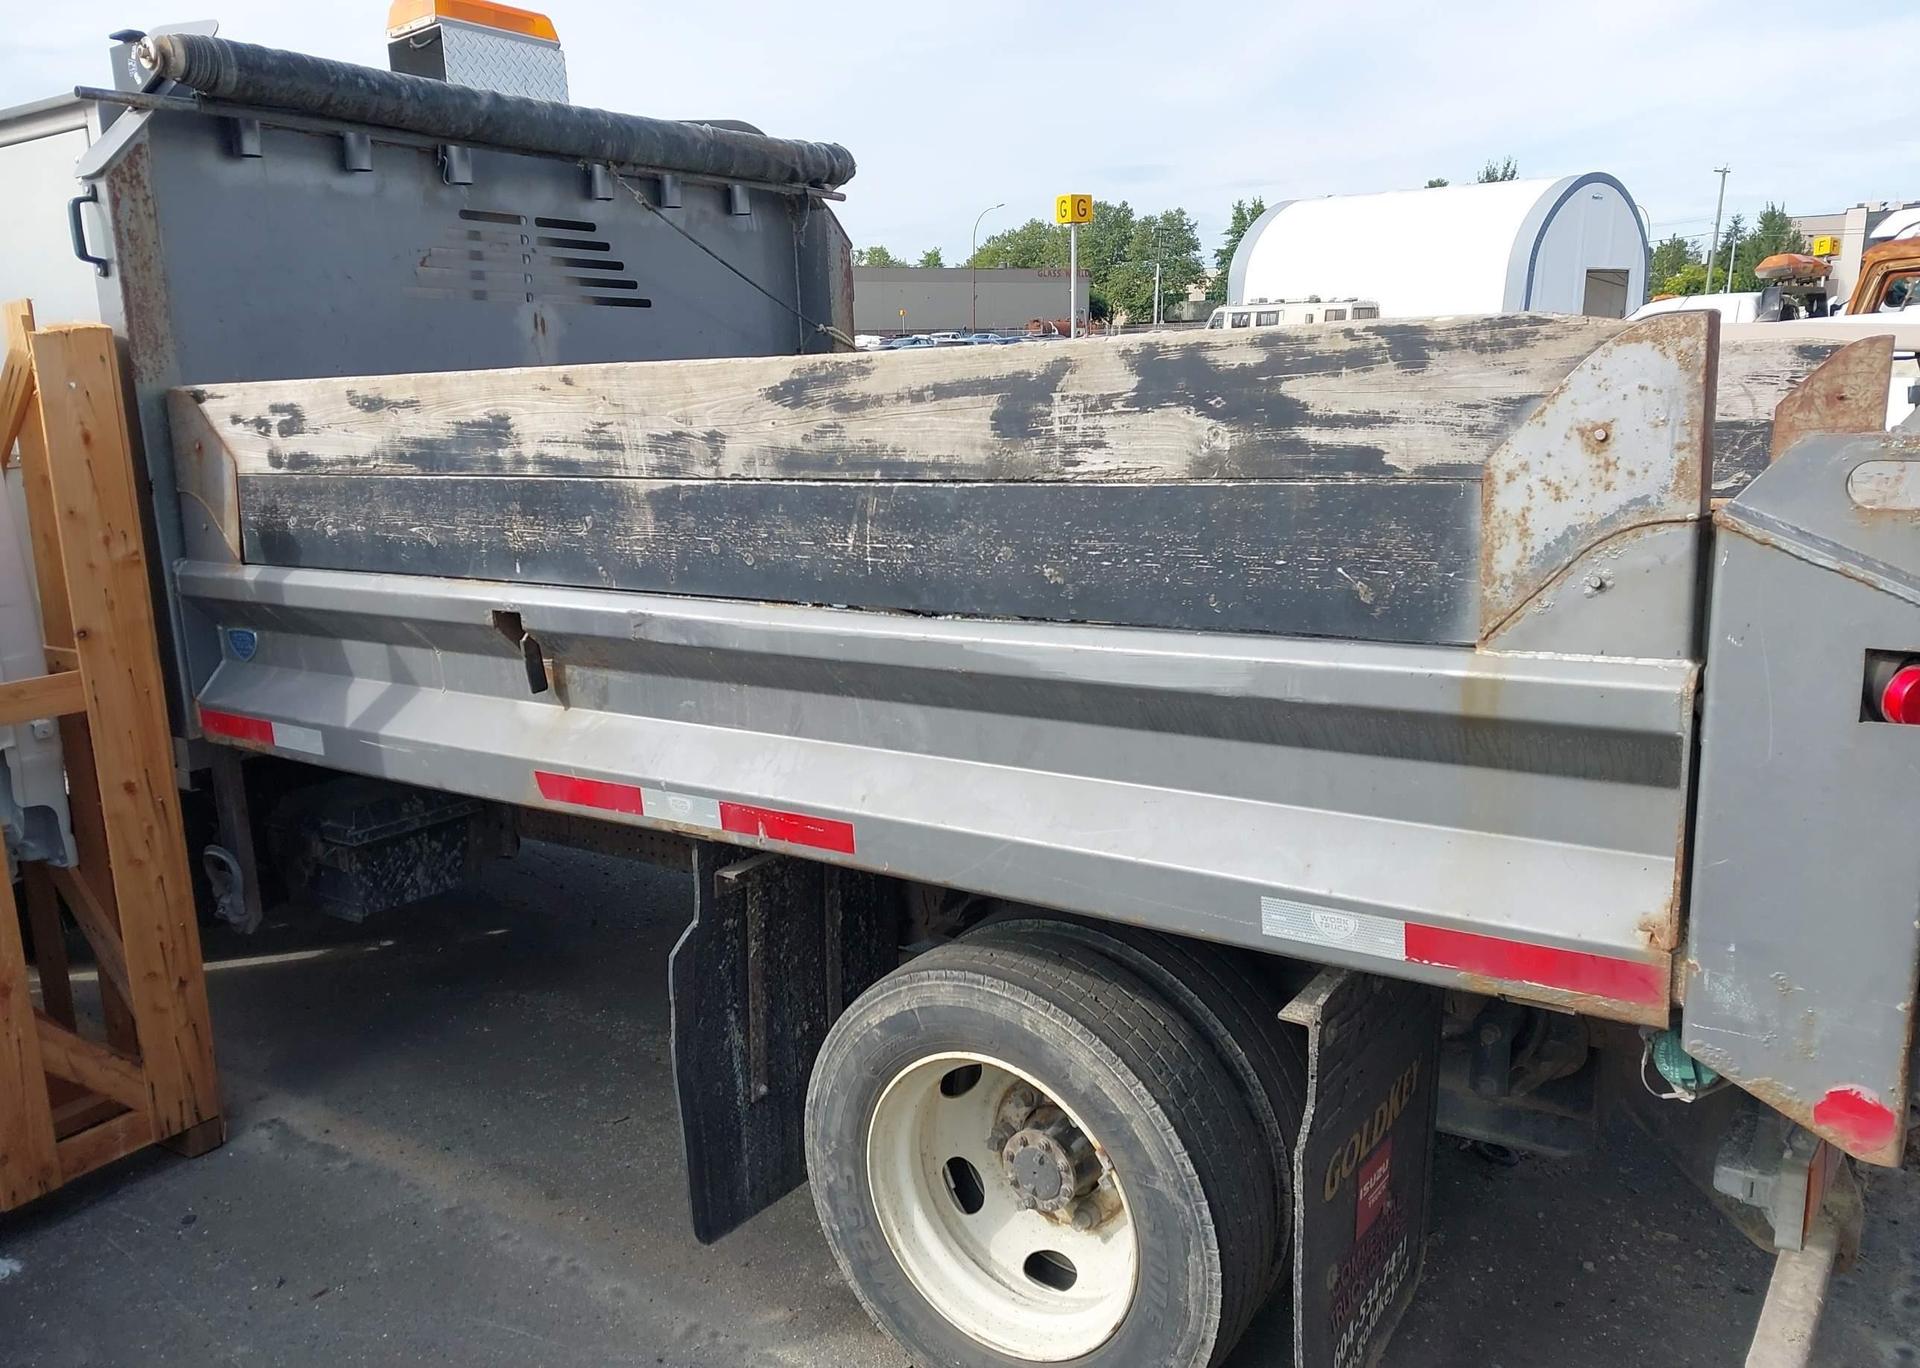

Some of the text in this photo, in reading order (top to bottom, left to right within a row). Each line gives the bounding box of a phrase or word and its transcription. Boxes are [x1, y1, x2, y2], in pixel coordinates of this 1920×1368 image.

[1060, 200, 1067, 218] G
[1077, 199, 1087, 217] G
[1818, 240, 1826, 252] F
[1832, 240, 1838, 252] F
[1038, 269, 1061, 278] GLASS
[1323, 1053, 1422, 1201] GOLDKEY
[1359, 1157, 1390, 1201] ISUZU
